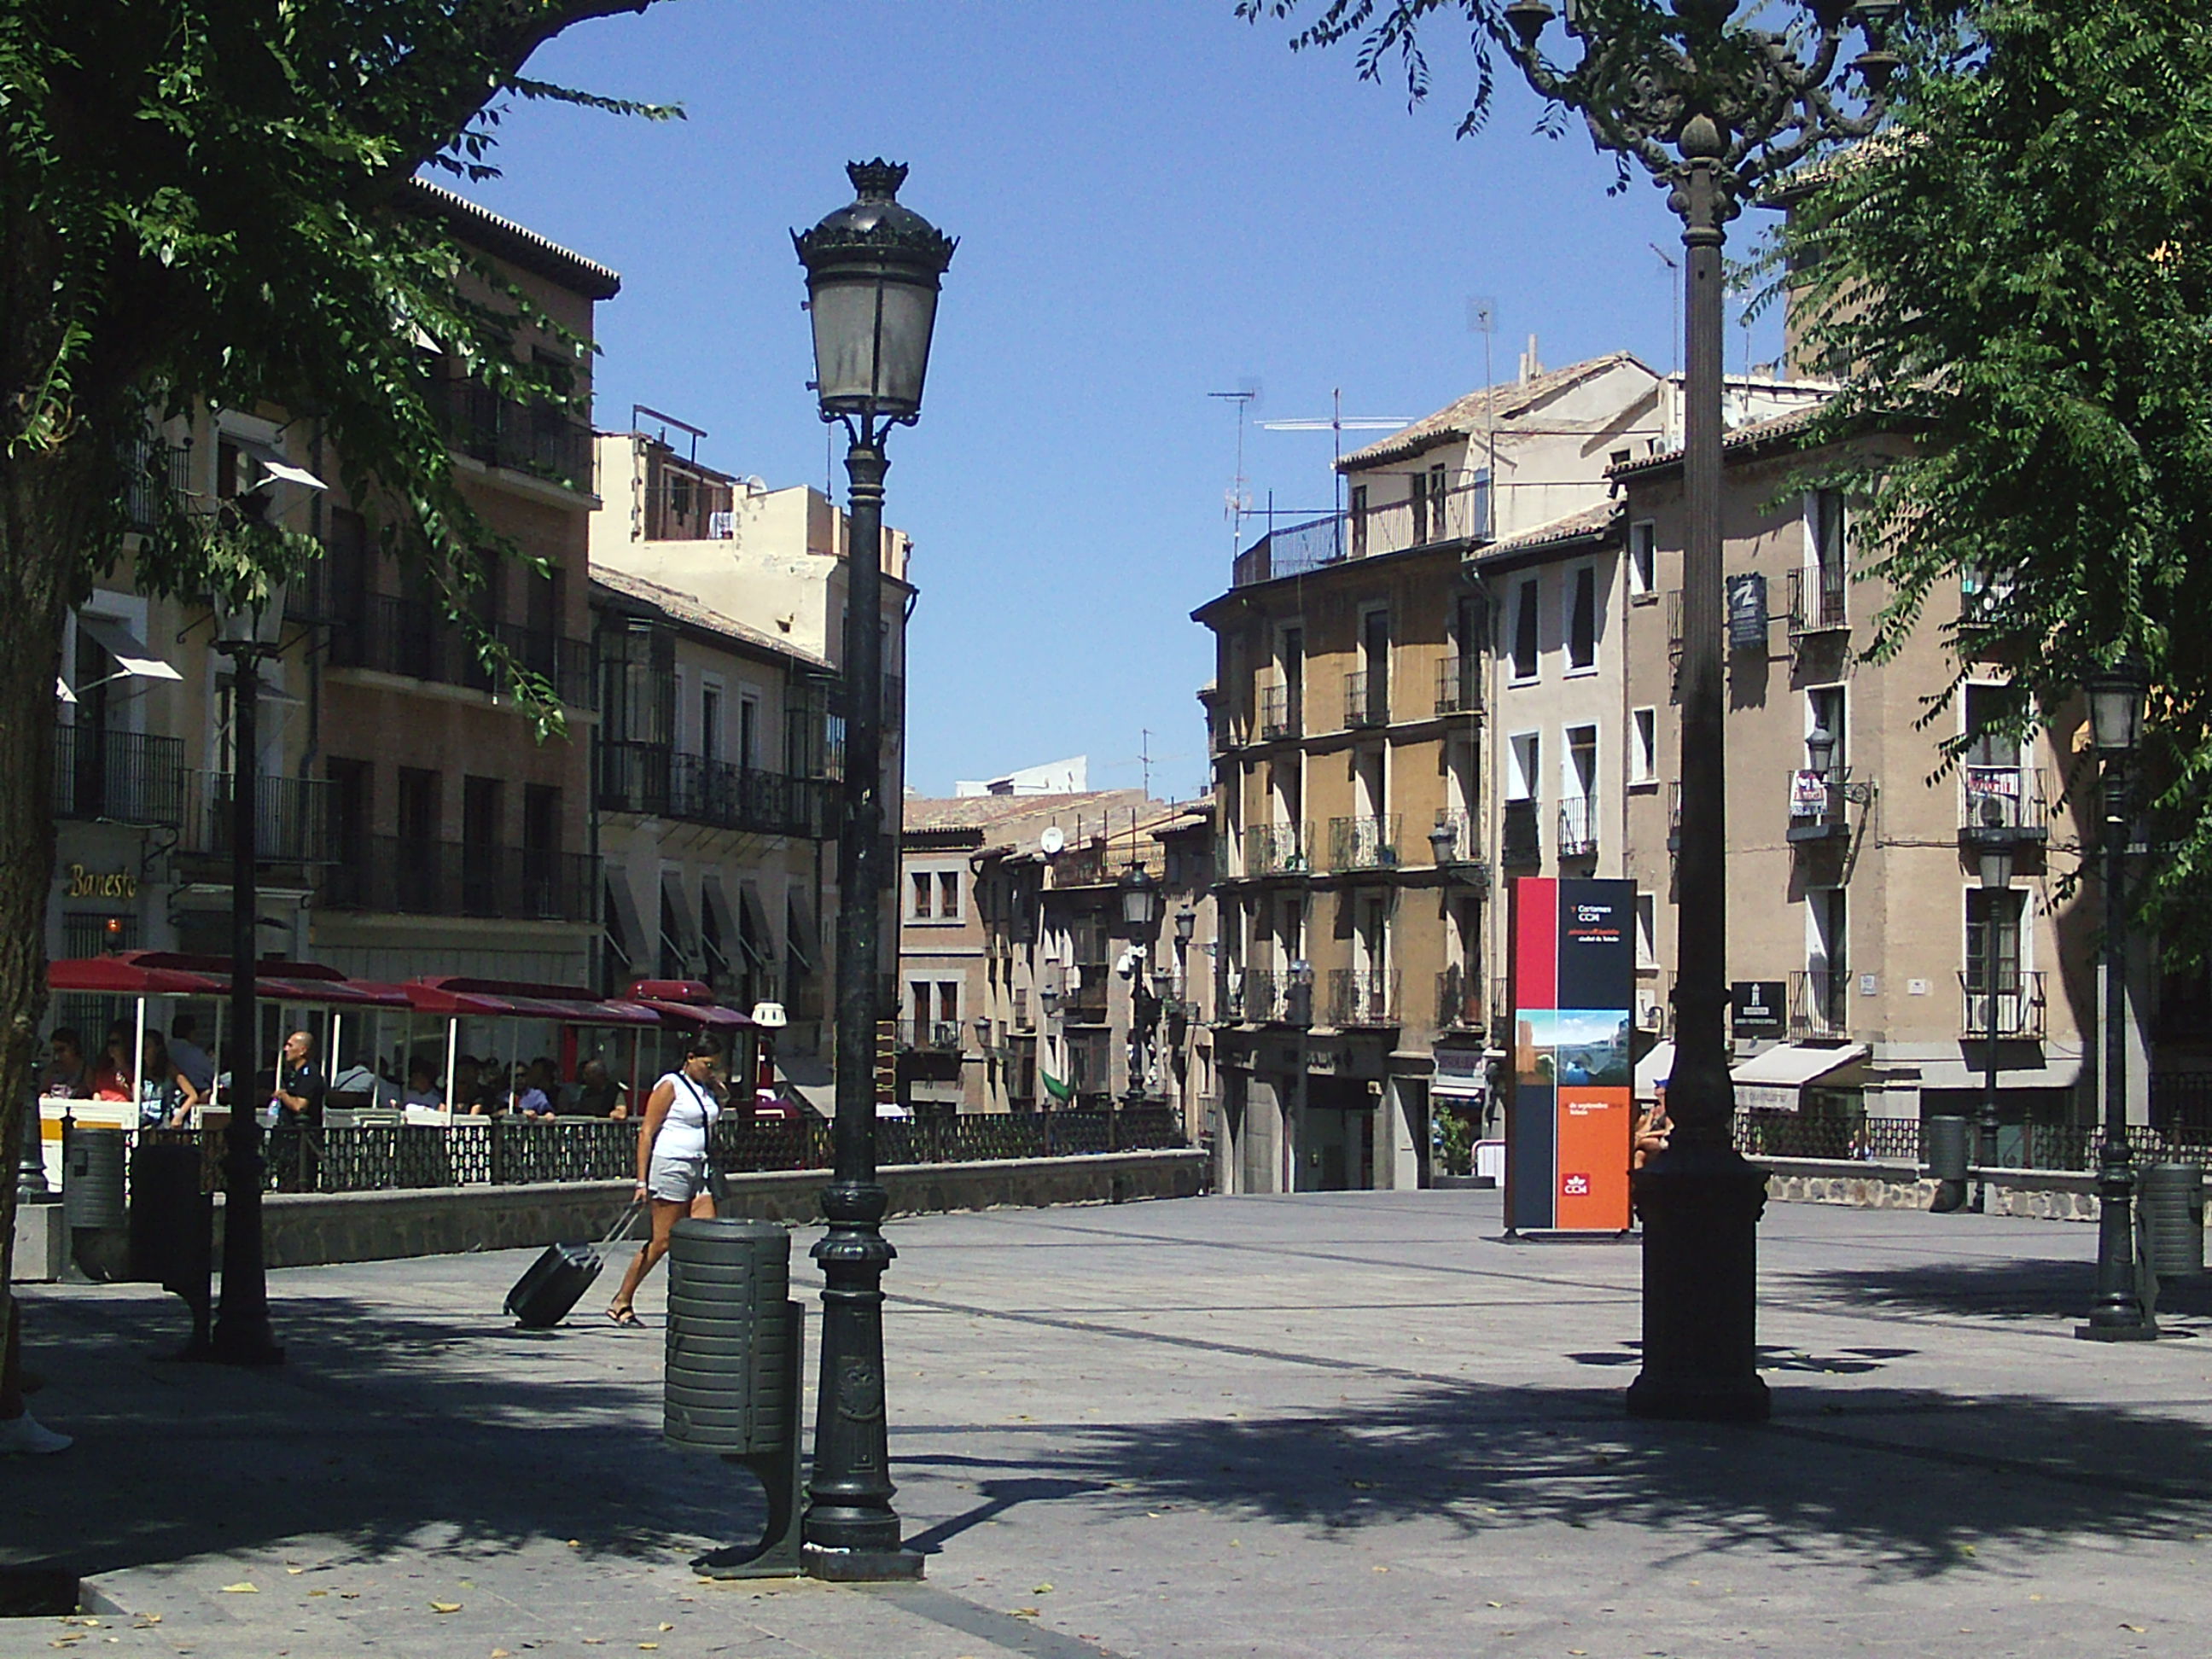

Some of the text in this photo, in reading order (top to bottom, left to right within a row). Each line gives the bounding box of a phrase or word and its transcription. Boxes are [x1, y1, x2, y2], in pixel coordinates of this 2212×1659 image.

[70, 864, 136, 898] Banesto
[1578, 913, 1600, 922] CCM
[1564, 1185, 1587, 1194] CCM
